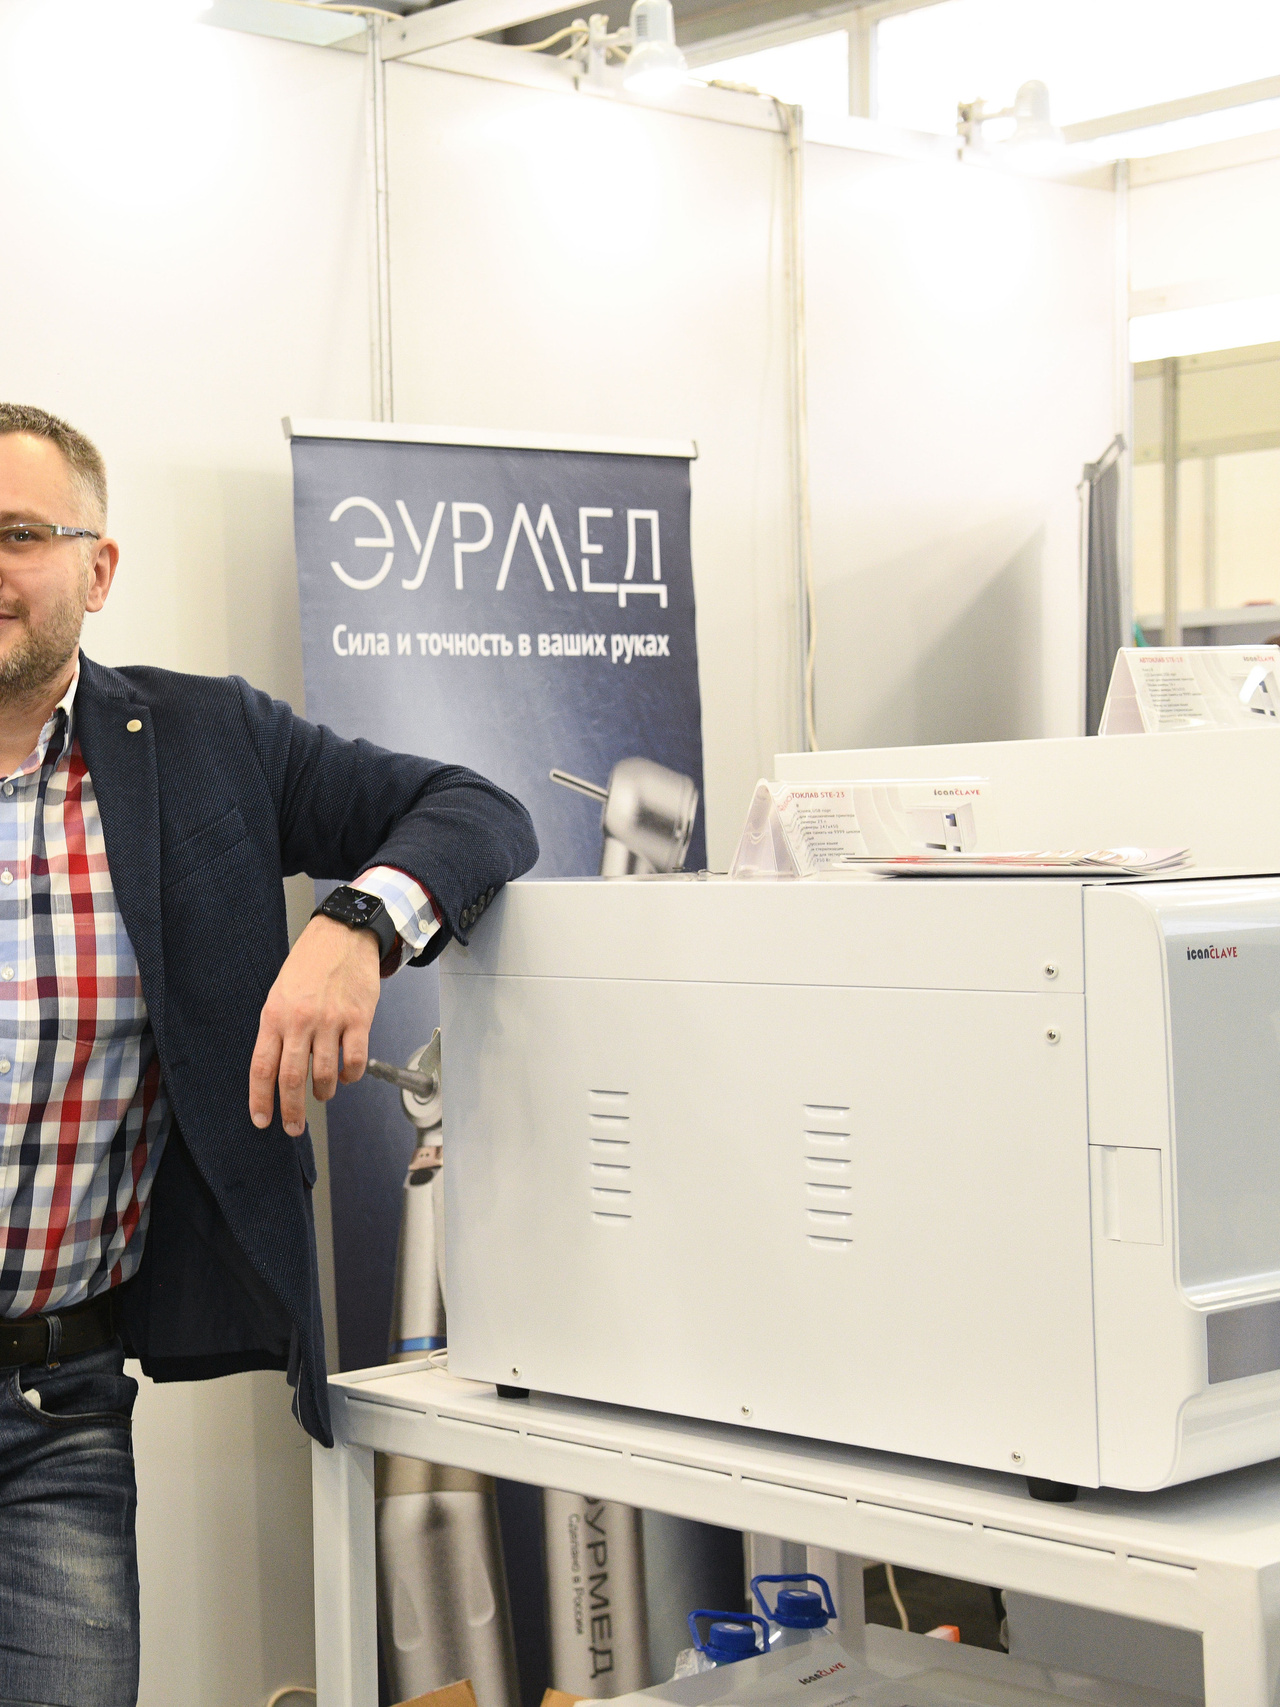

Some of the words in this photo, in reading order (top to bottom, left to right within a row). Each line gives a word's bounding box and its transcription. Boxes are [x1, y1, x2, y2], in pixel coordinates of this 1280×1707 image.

[328, 496, 668, 608] ЭУРМЕД
[332, 624, 390, 657] Сила
[397, 632, 411, 656] и
[416, 633, 513, 657] точность
[519, 633, 531, 656] в
[538, 634, 607, 658] ваших
[611, 633, 670, 664] руках
[820, 791, 845, 799] STE-23
